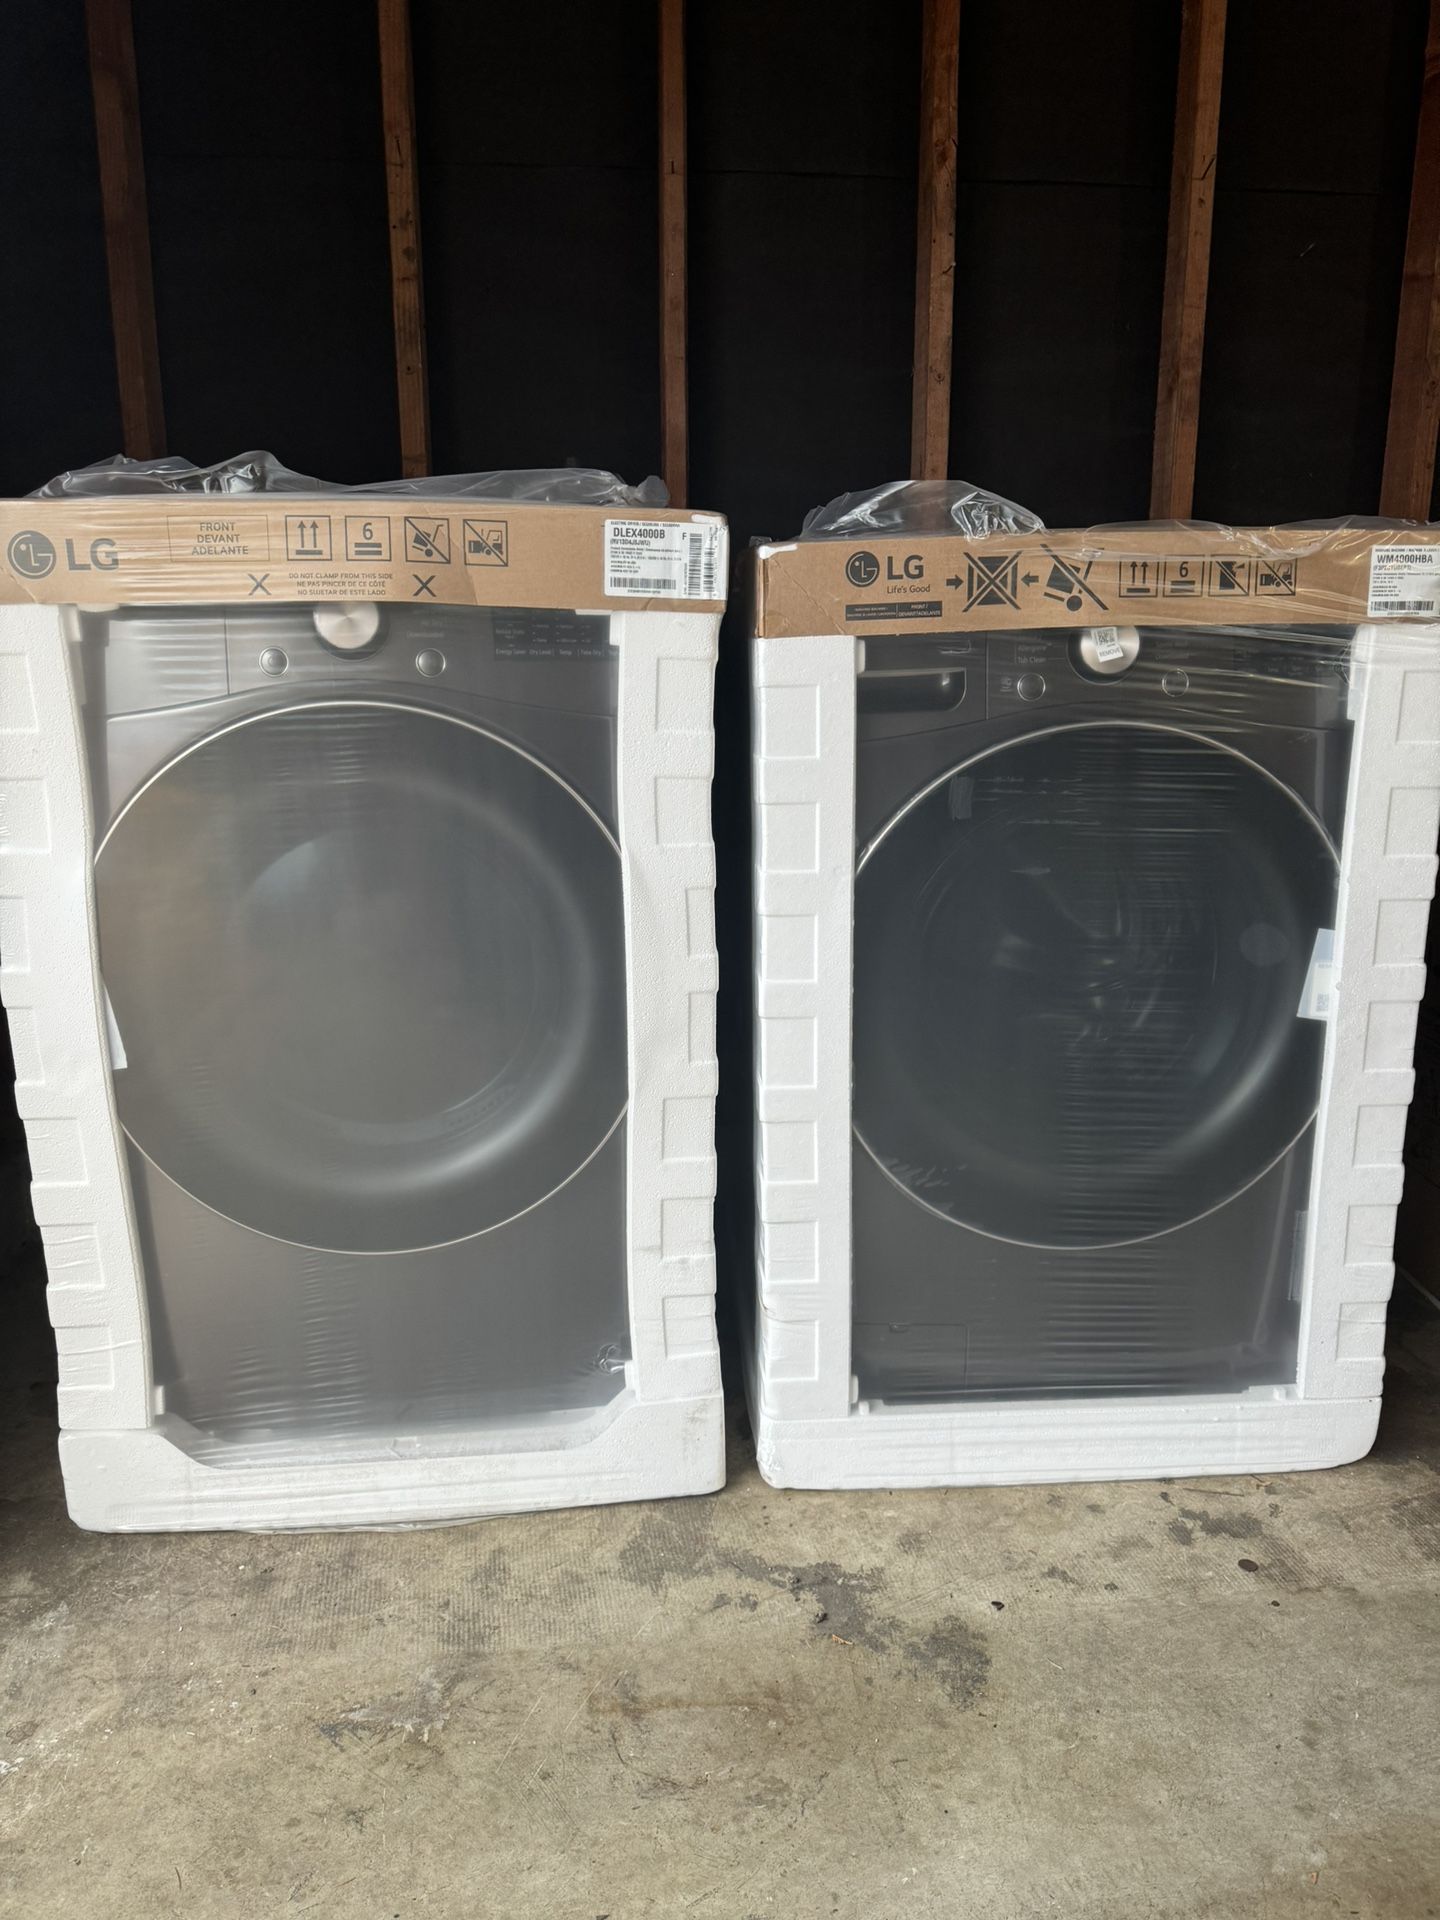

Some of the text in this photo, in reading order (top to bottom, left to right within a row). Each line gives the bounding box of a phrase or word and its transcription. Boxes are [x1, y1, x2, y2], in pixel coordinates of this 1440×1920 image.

[200, 522, 236, 531] FRONT
[363, 522, 373, 540] 6
[613, 527, 665, 539] DLEX4000B
[682, 532, 687, 540] F
[196, 534, 240, 543] DEVANT
[64, 538, 120, 571] LG
[191, 546, 249, 555] ADELANTE
[1377, 554, 1433, 563] WM4000HBA
[888, 555, 924, 579] LG
[1180, 561, 1189, 577] 6
[887, 584, 930, 593] Life's Good
[1099, 647, 1120, 657] REMOVE
